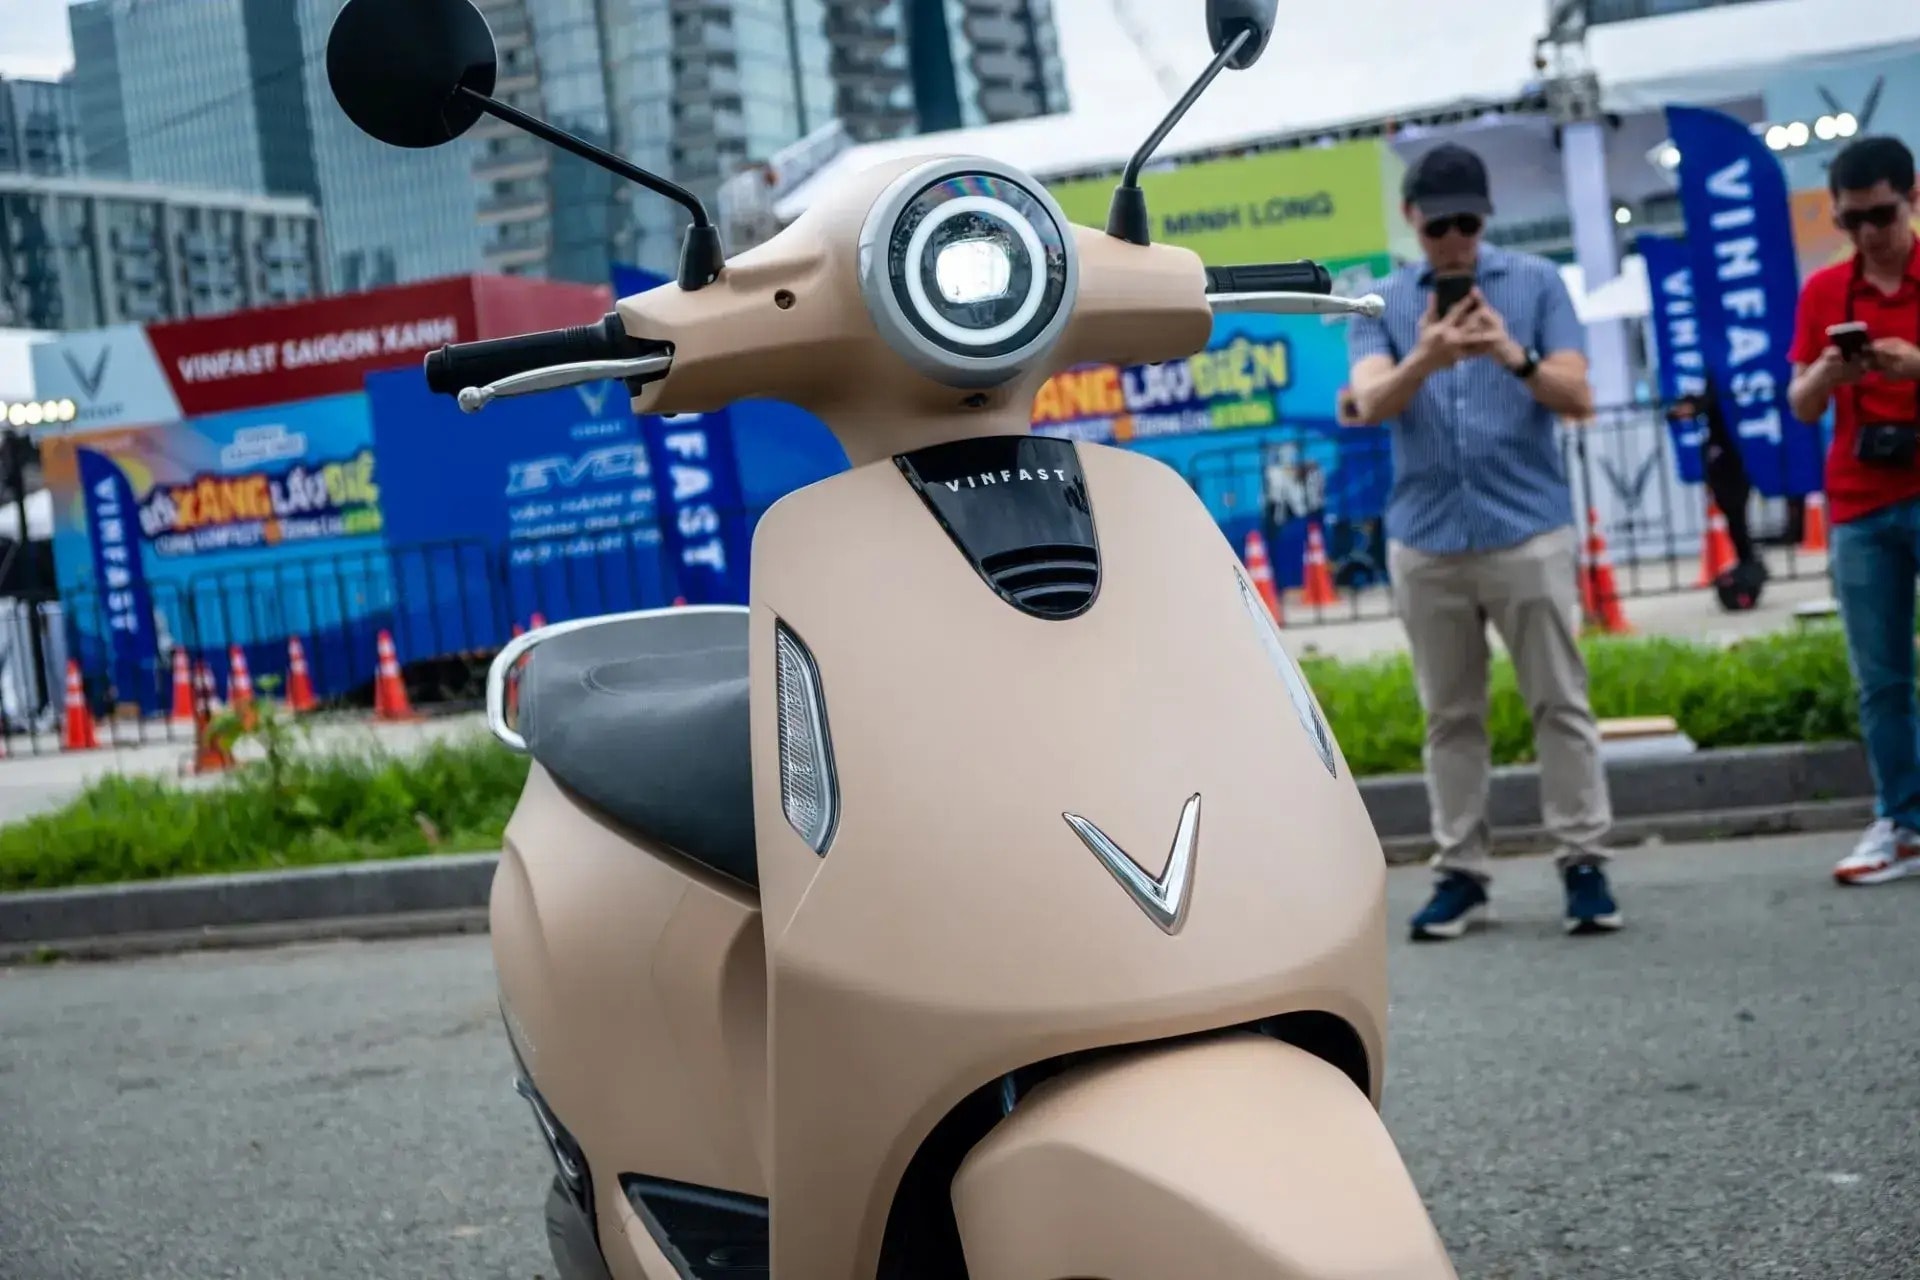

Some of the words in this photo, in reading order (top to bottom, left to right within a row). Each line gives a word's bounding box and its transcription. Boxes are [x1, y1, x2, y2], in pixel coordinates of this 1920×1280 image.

[1250, 190, 1335, 226] LONG
[177, 341, 278, 384] VINFAST
[281, 326, 377, 370] SAIGON
[380, 316, 458, 355] XANH
[1705, 157, 1783, 444] VINFAST
[660, 412, 726, 572] FAST
[944, 468, 1065, 493] VINFAST
[93, 474, 138, 634] VINFAST
